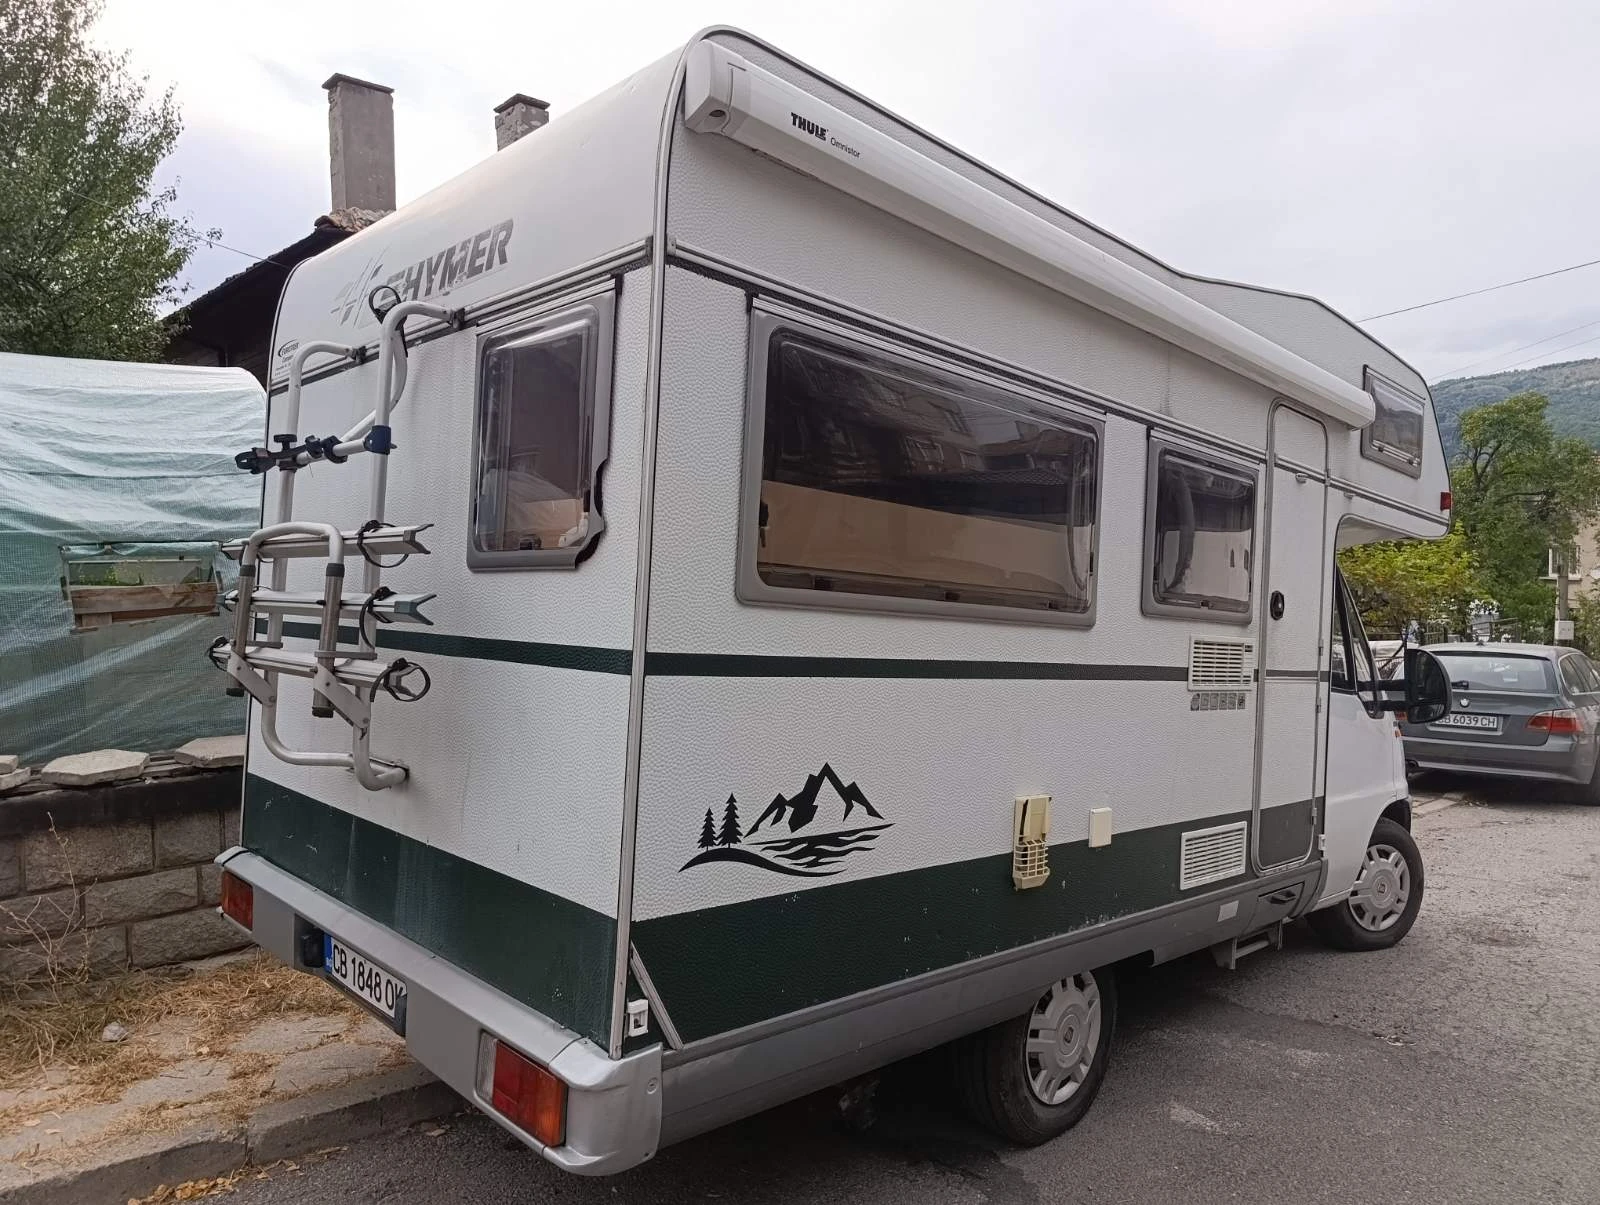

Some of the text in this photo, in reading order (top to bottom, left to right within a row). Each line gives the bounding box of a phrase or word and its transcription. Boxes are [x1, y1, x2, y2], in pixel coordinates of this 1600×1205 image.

[791, 112, 860, 158] THULE Omnistor
[1453, 715, 1479, 725] 6039
[1480, 716, 1496, 727] CH
[333, 944, 347, 979] CB
[351, 957, 382, 1003] 1848
